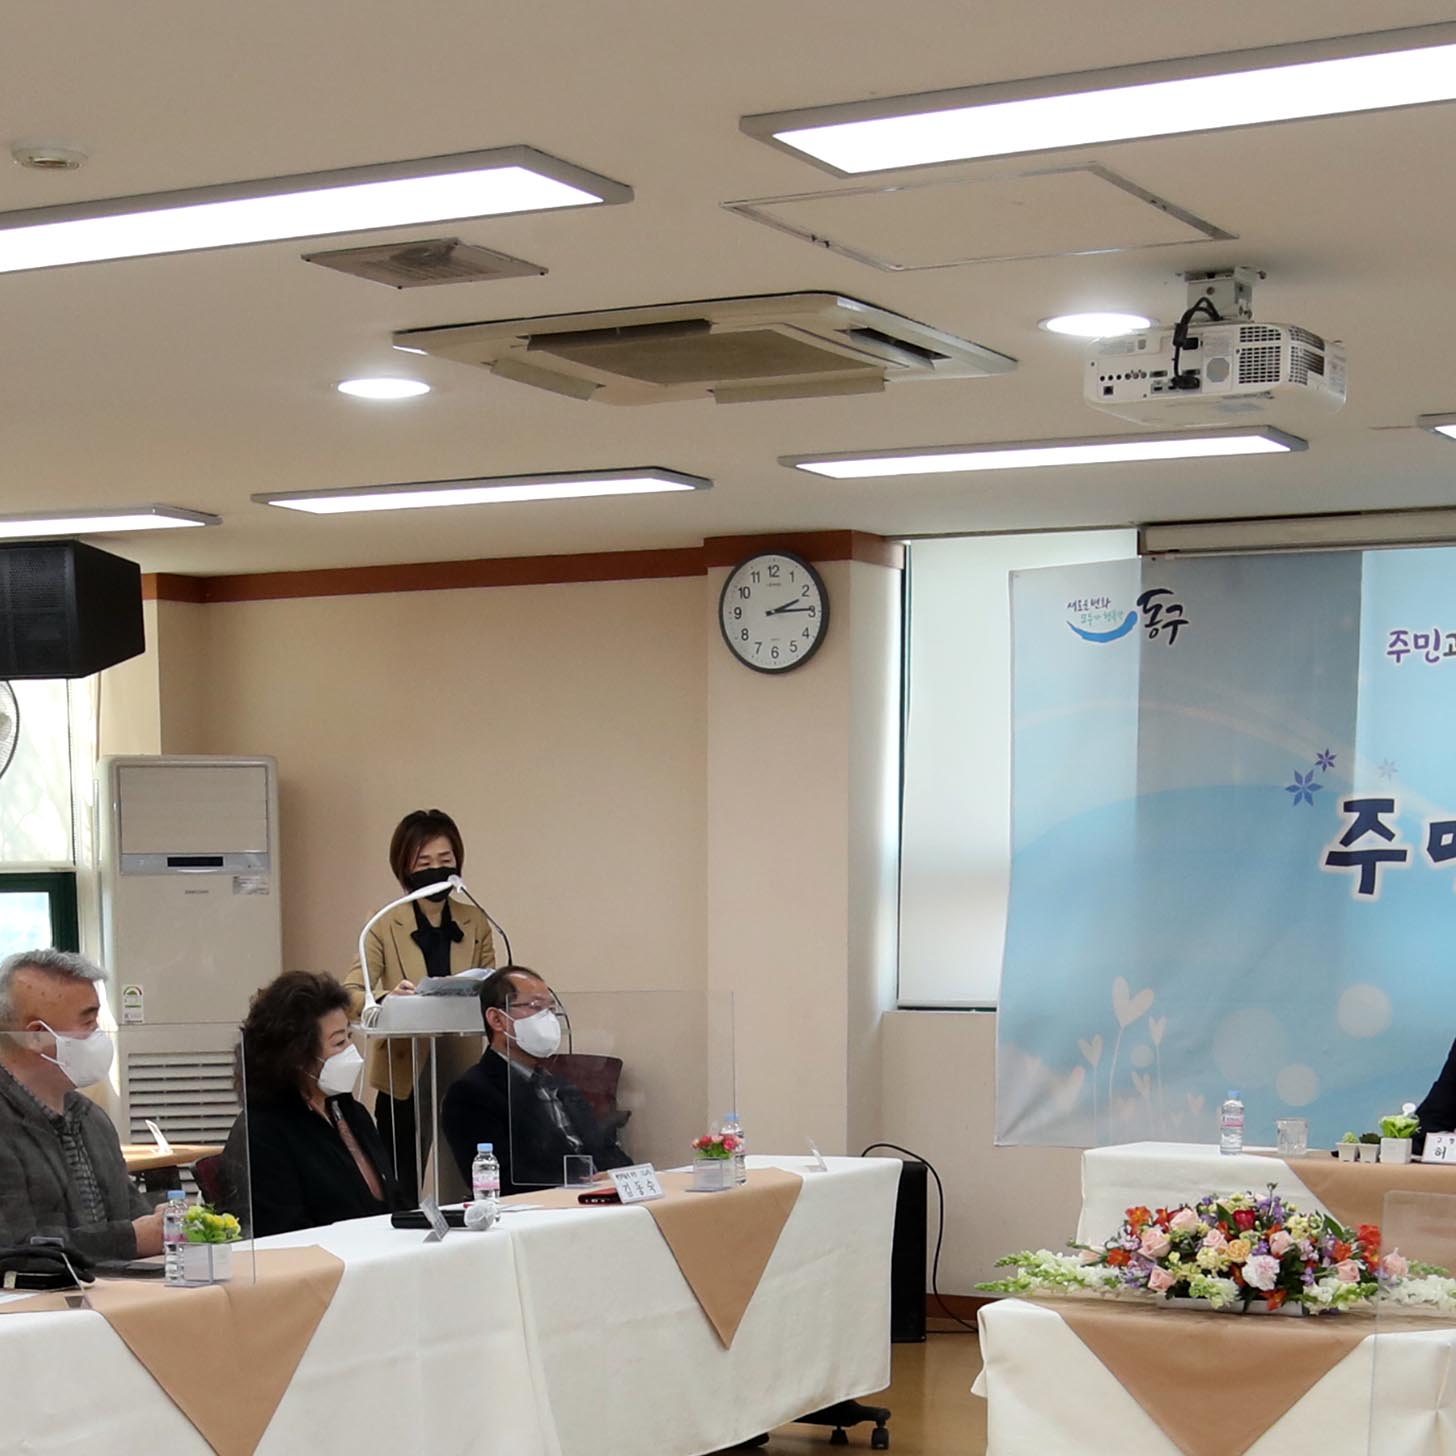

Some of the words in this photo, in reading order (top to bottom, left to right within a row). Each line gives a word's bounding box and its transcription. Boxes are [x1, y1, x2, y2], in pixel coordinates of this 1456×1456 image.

[750, 571, 761, 583] 11
[767, 565, 780, 578] 12
[789, 571, 795, 583] 1
[738, 586, 751, 599] 10
[801, 584, 810, 597] 2
[734, 607, 742, 620] 9
[741, 628, 749, 641] 8
[802, 627, 810, 639] 4
[754, 642, 762, 654] 7
[771, 646, 779, 659] 6
[790, 641, 798, 653] 5
